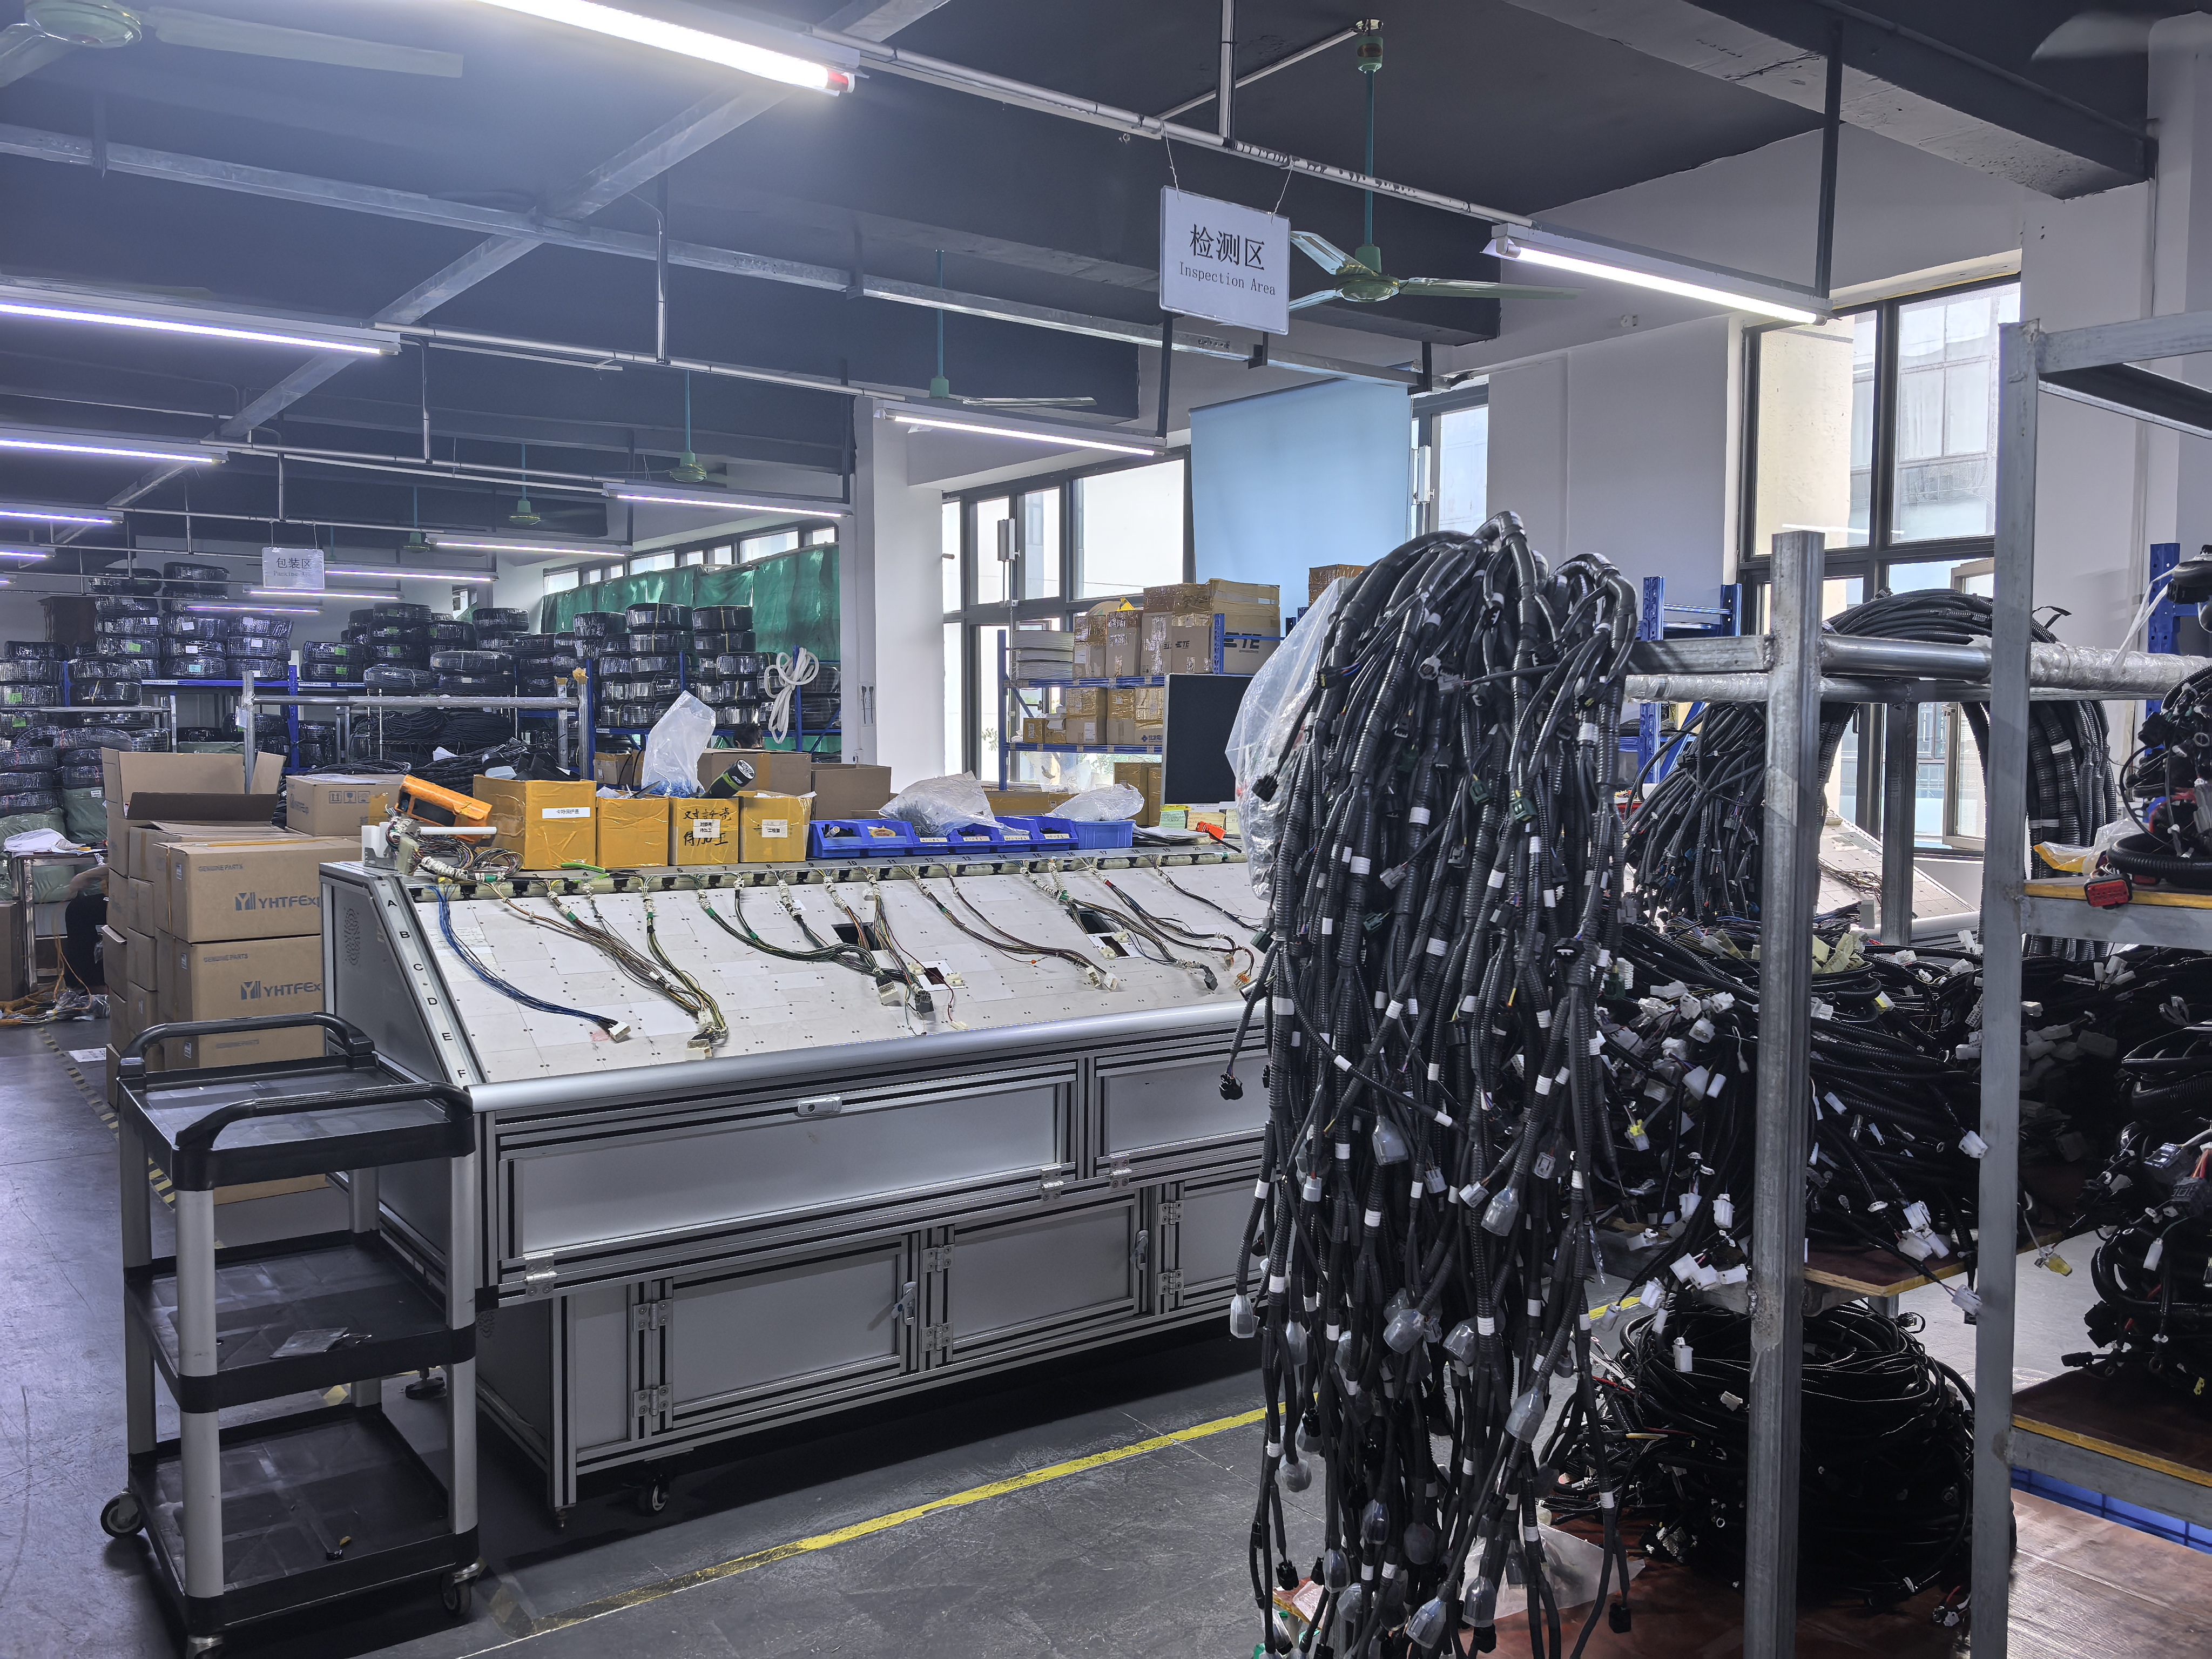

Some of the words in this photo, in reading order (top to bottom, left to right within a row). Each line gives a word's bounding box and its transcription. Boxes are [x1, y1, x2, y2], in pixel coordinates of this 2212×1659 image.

[1190, 224, 1265, 271] 检测区
[1179, 261, 1245, 288] Inspection
[1250, 278, 1276, 295] Area
[276, 557, 312, 569] 包装区
[442, 1033, 453, 1041] E
[457, 1070, 466, 1078] F
